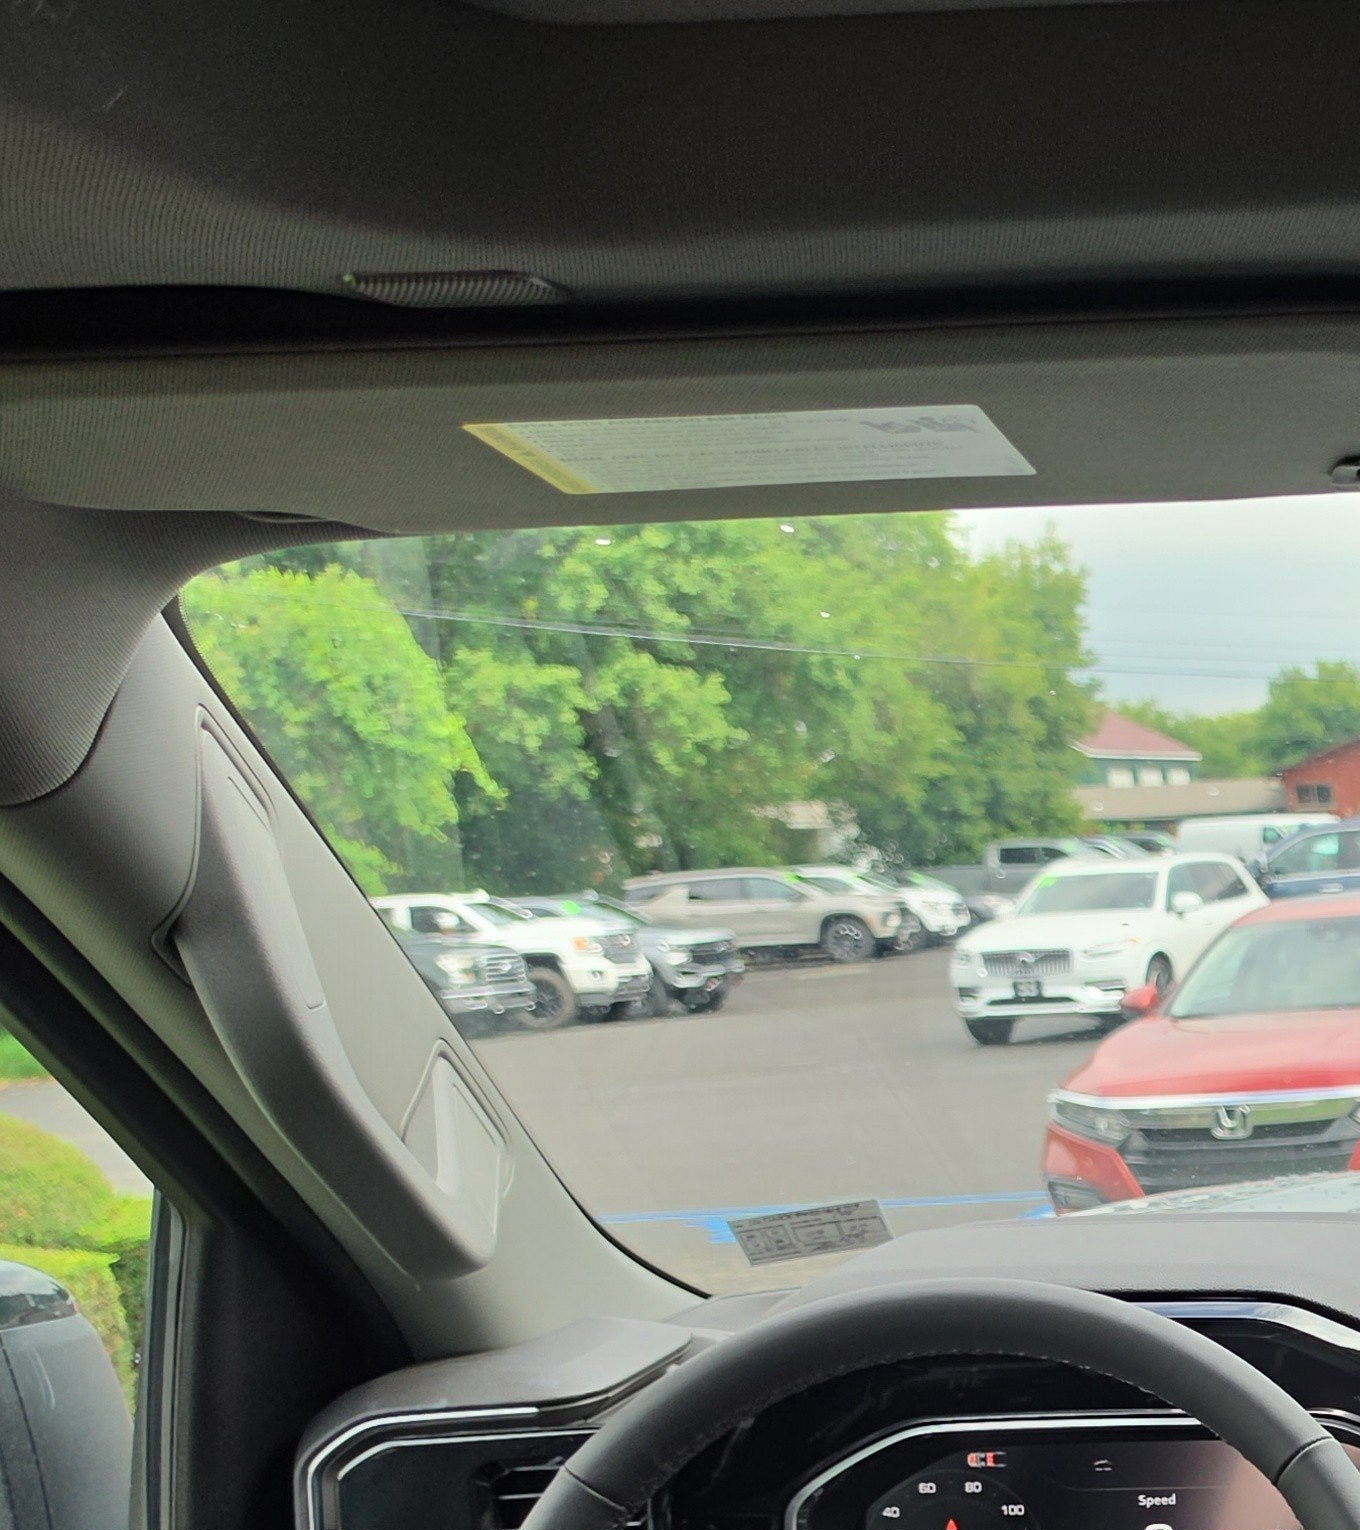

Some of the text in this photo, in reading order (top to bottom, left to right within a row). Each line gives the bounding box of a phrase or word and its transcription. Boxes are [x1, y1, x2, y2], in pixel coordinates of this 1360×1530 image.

[918, 1482, 937, 1494] 60
[964, 1481, 982, 1493] 80
[1138, 1493, 1176, 1509] Speed
[882, 1506, 900, 1518] 40
[1001, 1504, 1025, 1516] 100
